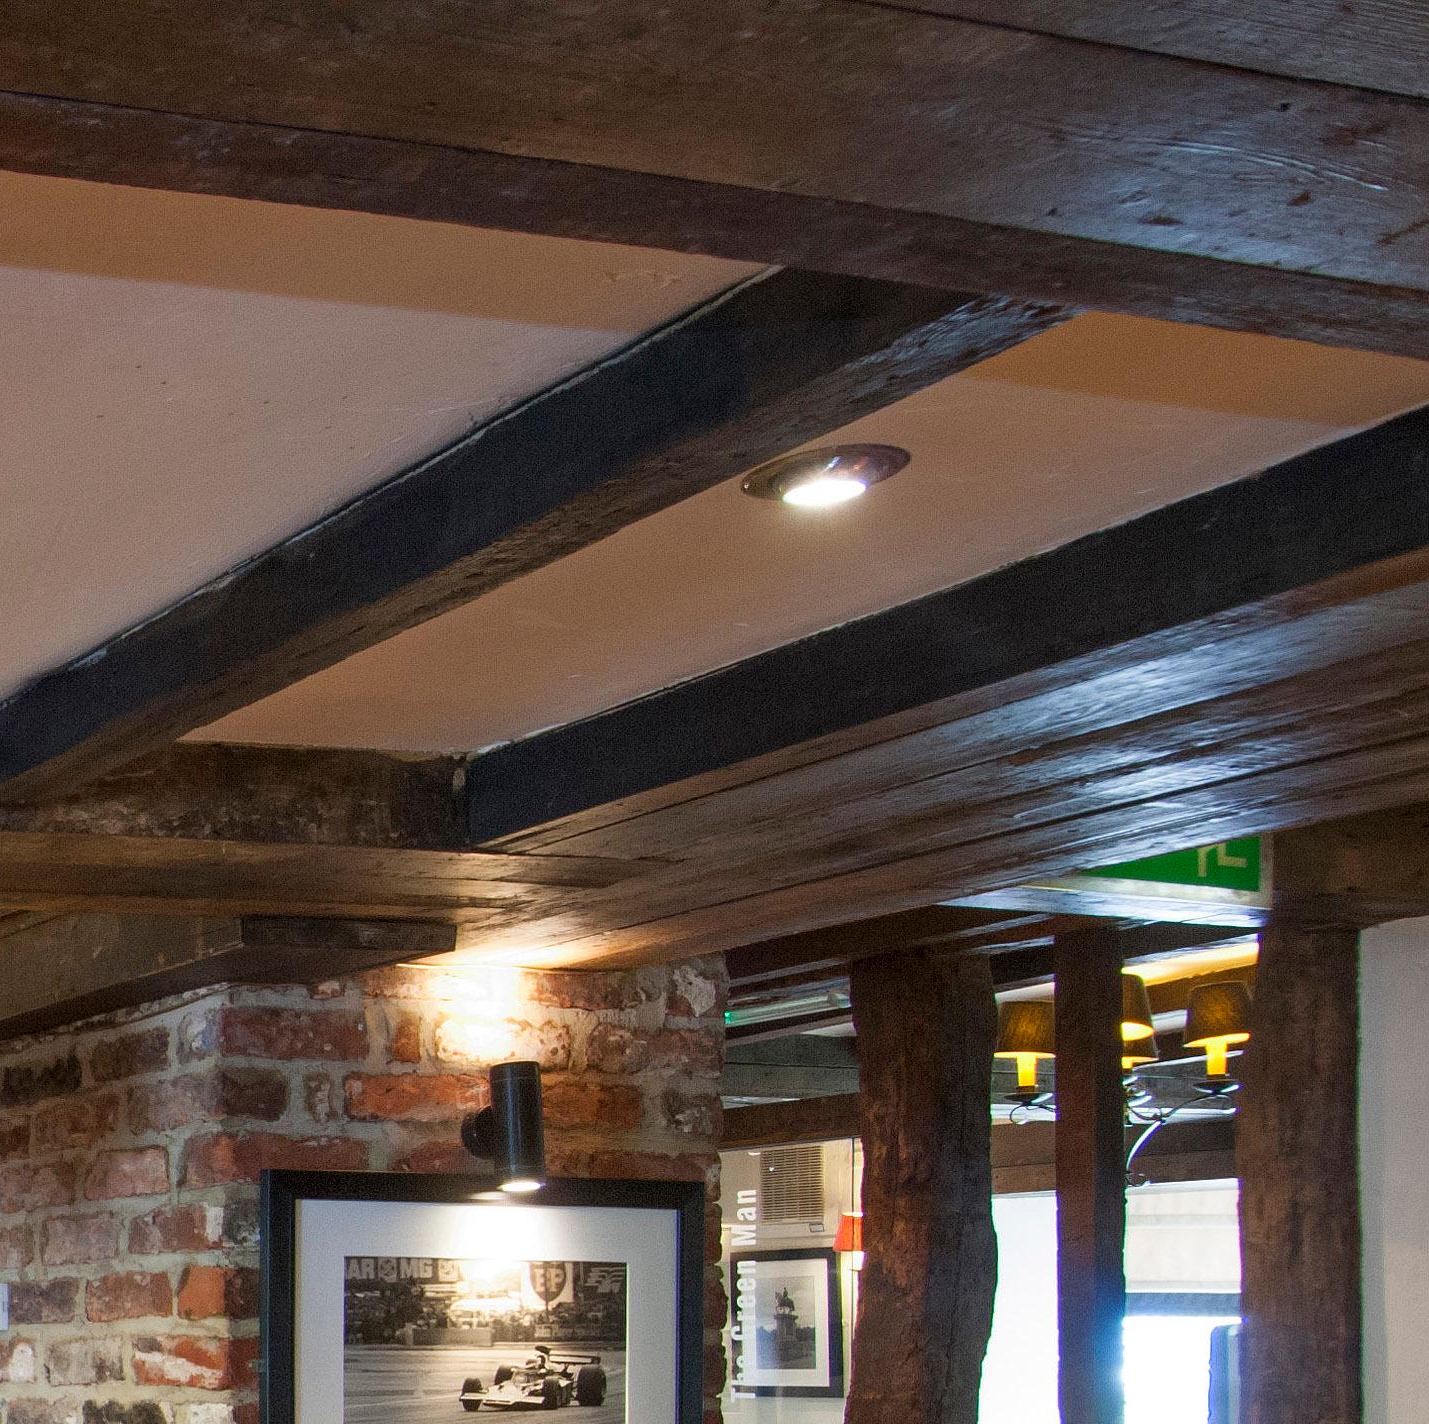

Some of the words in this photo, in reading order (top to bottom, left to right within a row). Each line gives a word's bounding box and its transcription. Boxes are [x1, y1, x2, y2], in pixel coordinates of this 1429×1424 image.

[731, 1190, 757, 1247] Man
[400, 1258, 433, 1279] MG
[730, 1260, 757, 1340] Green
